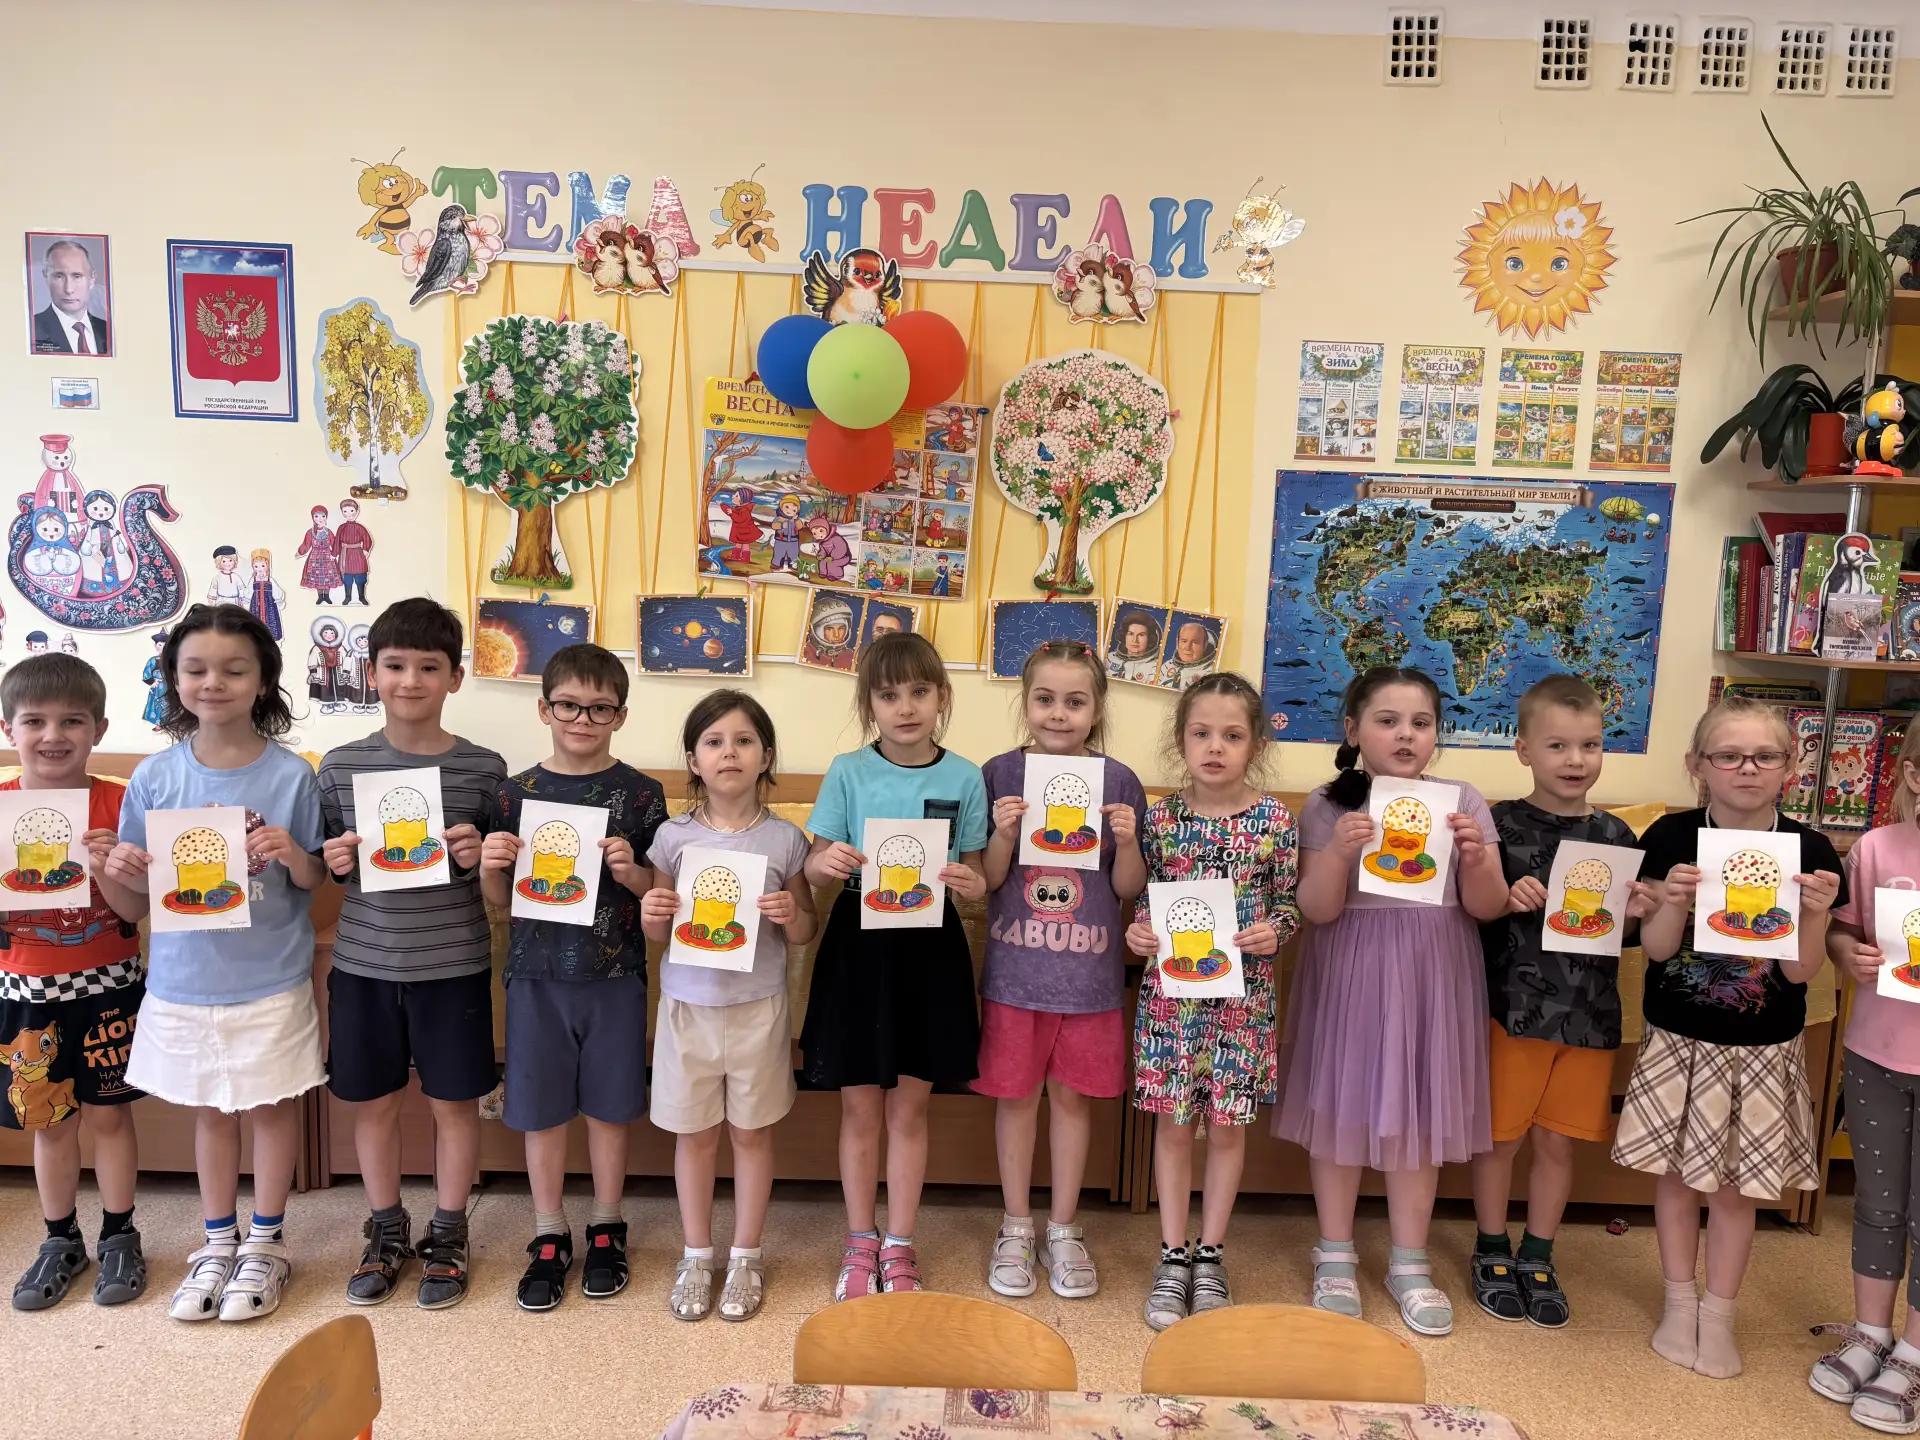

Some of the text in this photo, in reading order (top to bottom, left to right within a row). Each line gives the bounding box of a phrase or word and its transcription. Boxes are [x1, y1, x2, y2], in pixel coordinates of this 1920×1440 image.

[431, 166, 1214, 279] ТЕМА НЕДЕЛИ
[1311, 344, 1375, 355] ВРЕМЕНА ГОДА
[1412, 348, 1476, 358] ВРЕМЕНА ГОДА
[1326, 358, 1358, 368] ЗИМА
[1425, 362, 1460, 372] ВЕСНА
[1525, 361, 1558, 371] ЛЕТО
[1620, 364, 1657, 373] ОСЕНЬ
[717, 381, 769, 395] ВРЕМЕН
[726, 395, 796, 417] ВЕСНА
[1378, 485, 1433, 495] ЖИВОТНЫЙ
[1444, 487, 1516, 498] РАСТИТЕЛЬНЫЙ
[1517, 490, 1537, 499] МИР
[1538, 491, 1571, 500] ЗЕМЛИ
[990, 913, 1109, 954] LABUBU
[100, 1008, 120, 1020] The
[83, 1044, 132, 1068] Kin
